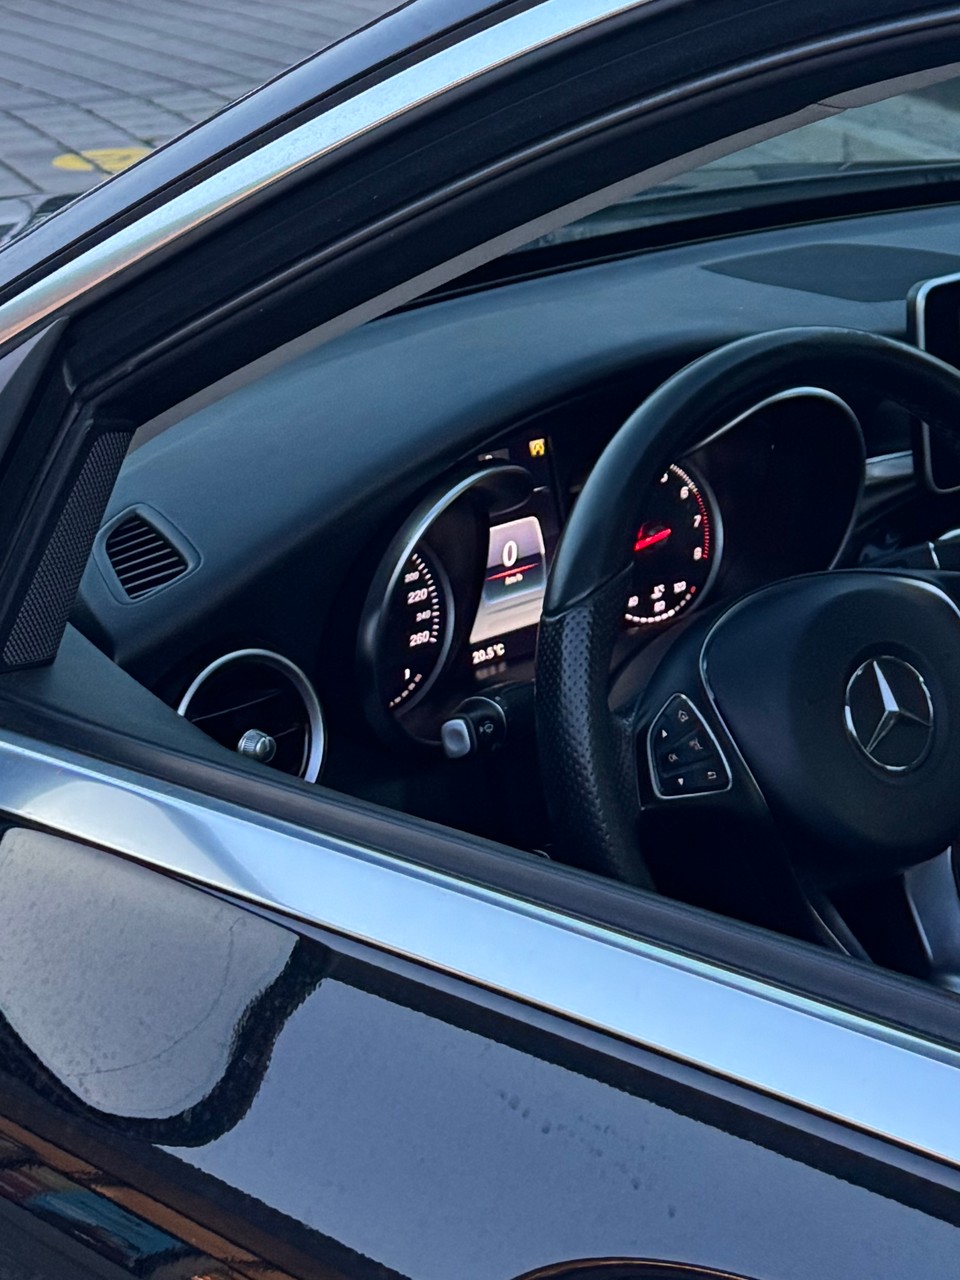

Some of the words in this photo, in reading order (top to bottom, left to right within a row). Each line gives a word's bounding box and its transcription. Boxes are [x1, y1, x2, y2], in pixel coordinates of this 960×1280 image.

[680, 485, 689, 500] 6
[693, 514, 702, 528] 7
[502, 540, 518, 568] 0
[407, 587, 429, 605] 220
[409, 630, 430, 648] 260
